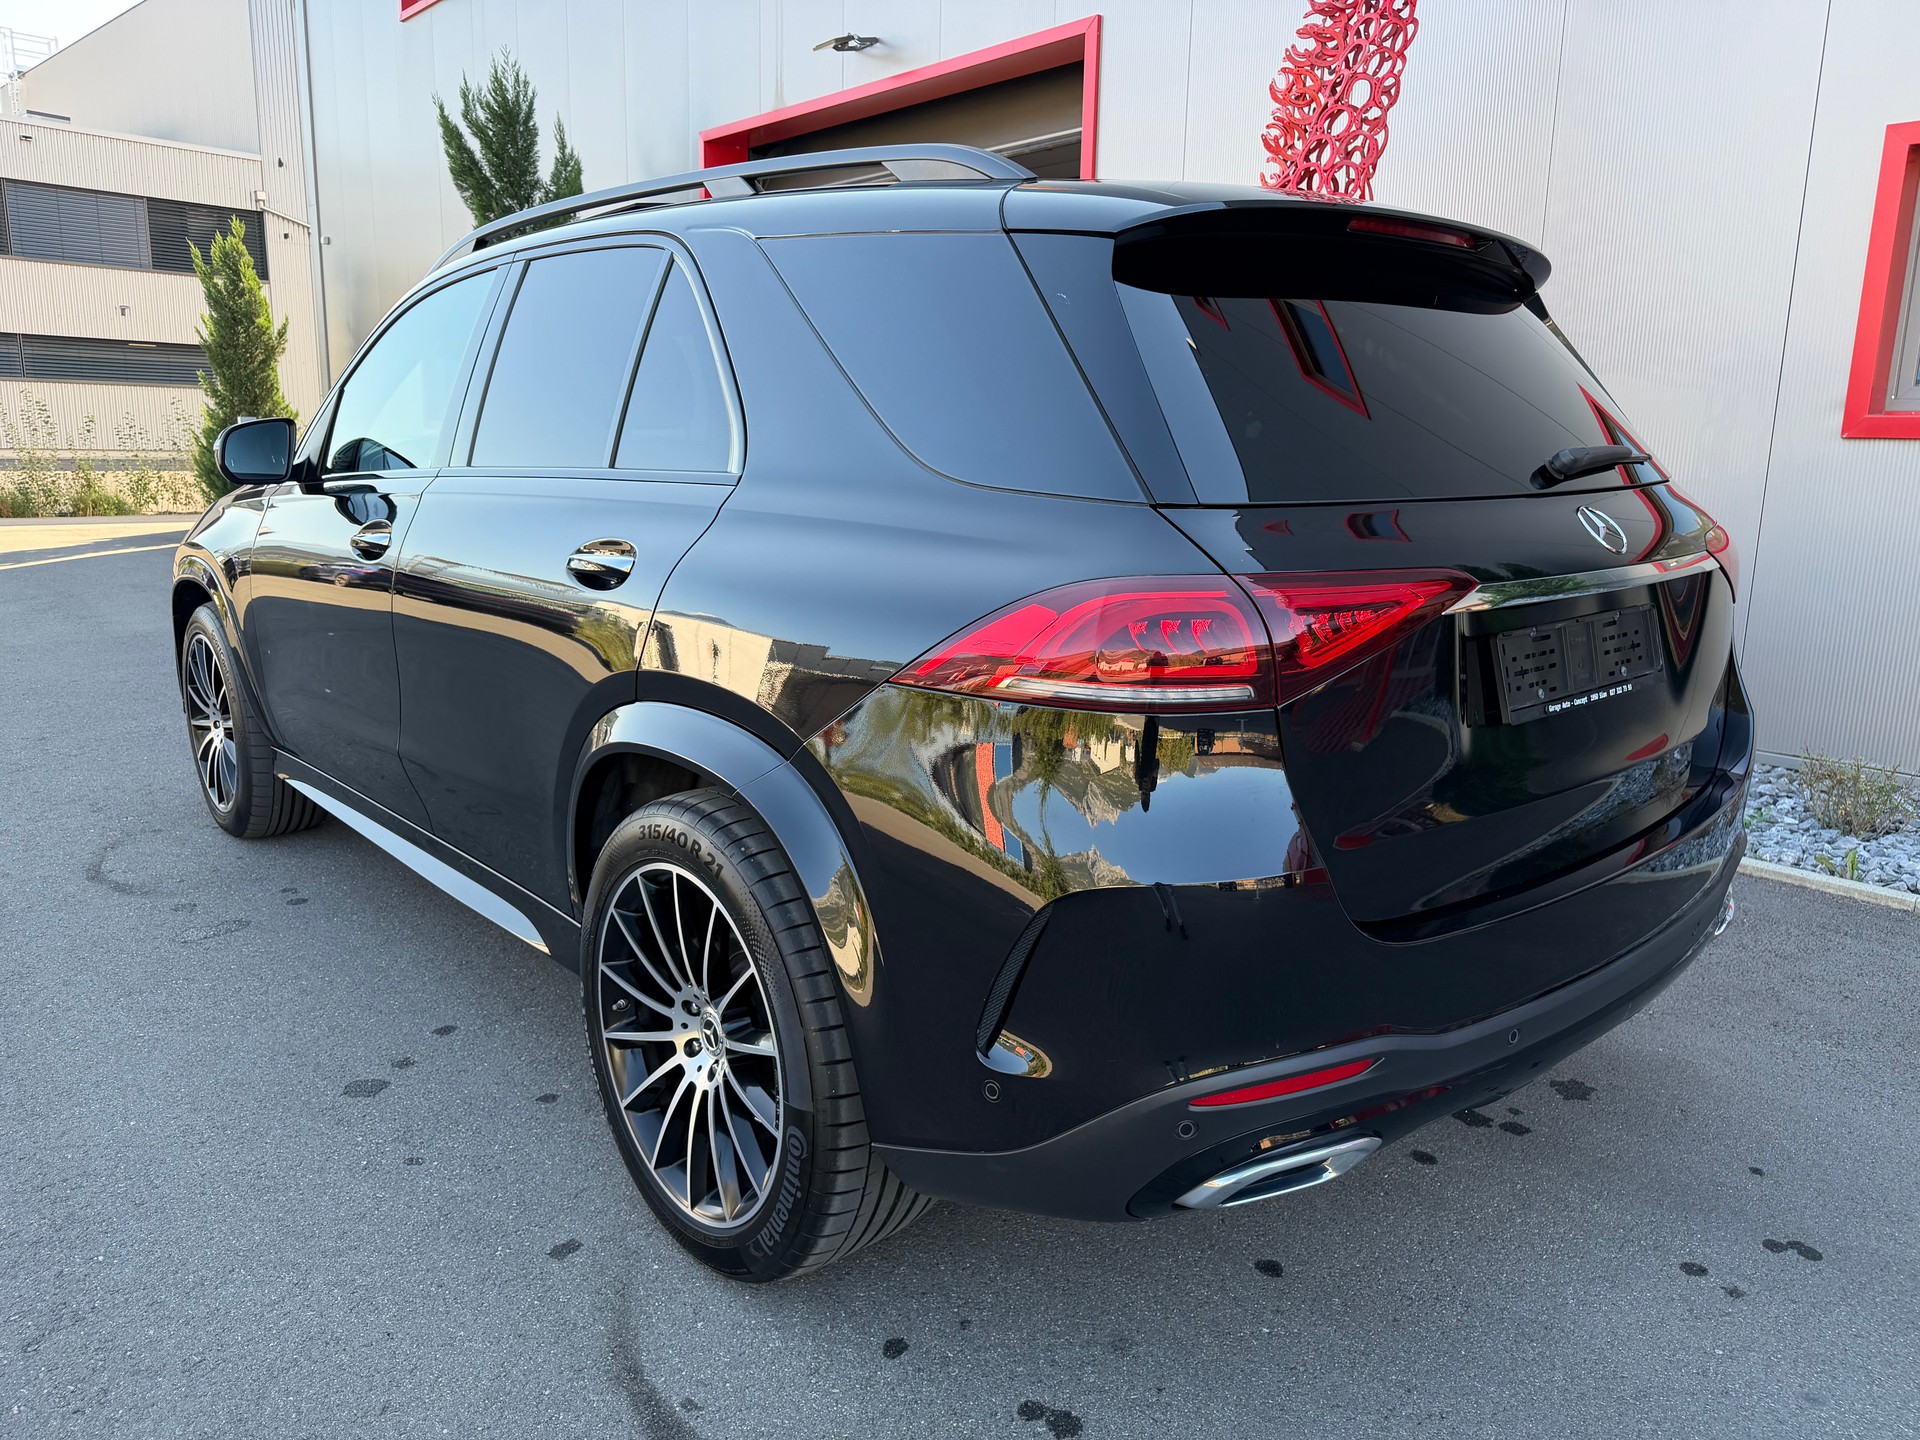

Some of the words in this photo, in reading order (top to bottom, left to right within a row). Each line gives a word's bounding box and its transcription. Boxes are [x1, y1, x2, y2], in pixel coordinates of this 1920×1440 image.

[1549, 704, 1561, 712] Garage
[1573, 696, 1588, 705] Concept
[1599, 690, 1608, 699] Sion
[638, 823, 689, 850] 315/40
[689, 838, 702, 860] R
[703, 851, 725, 880] 21
[757, 1125, 809, 1256] Continental
